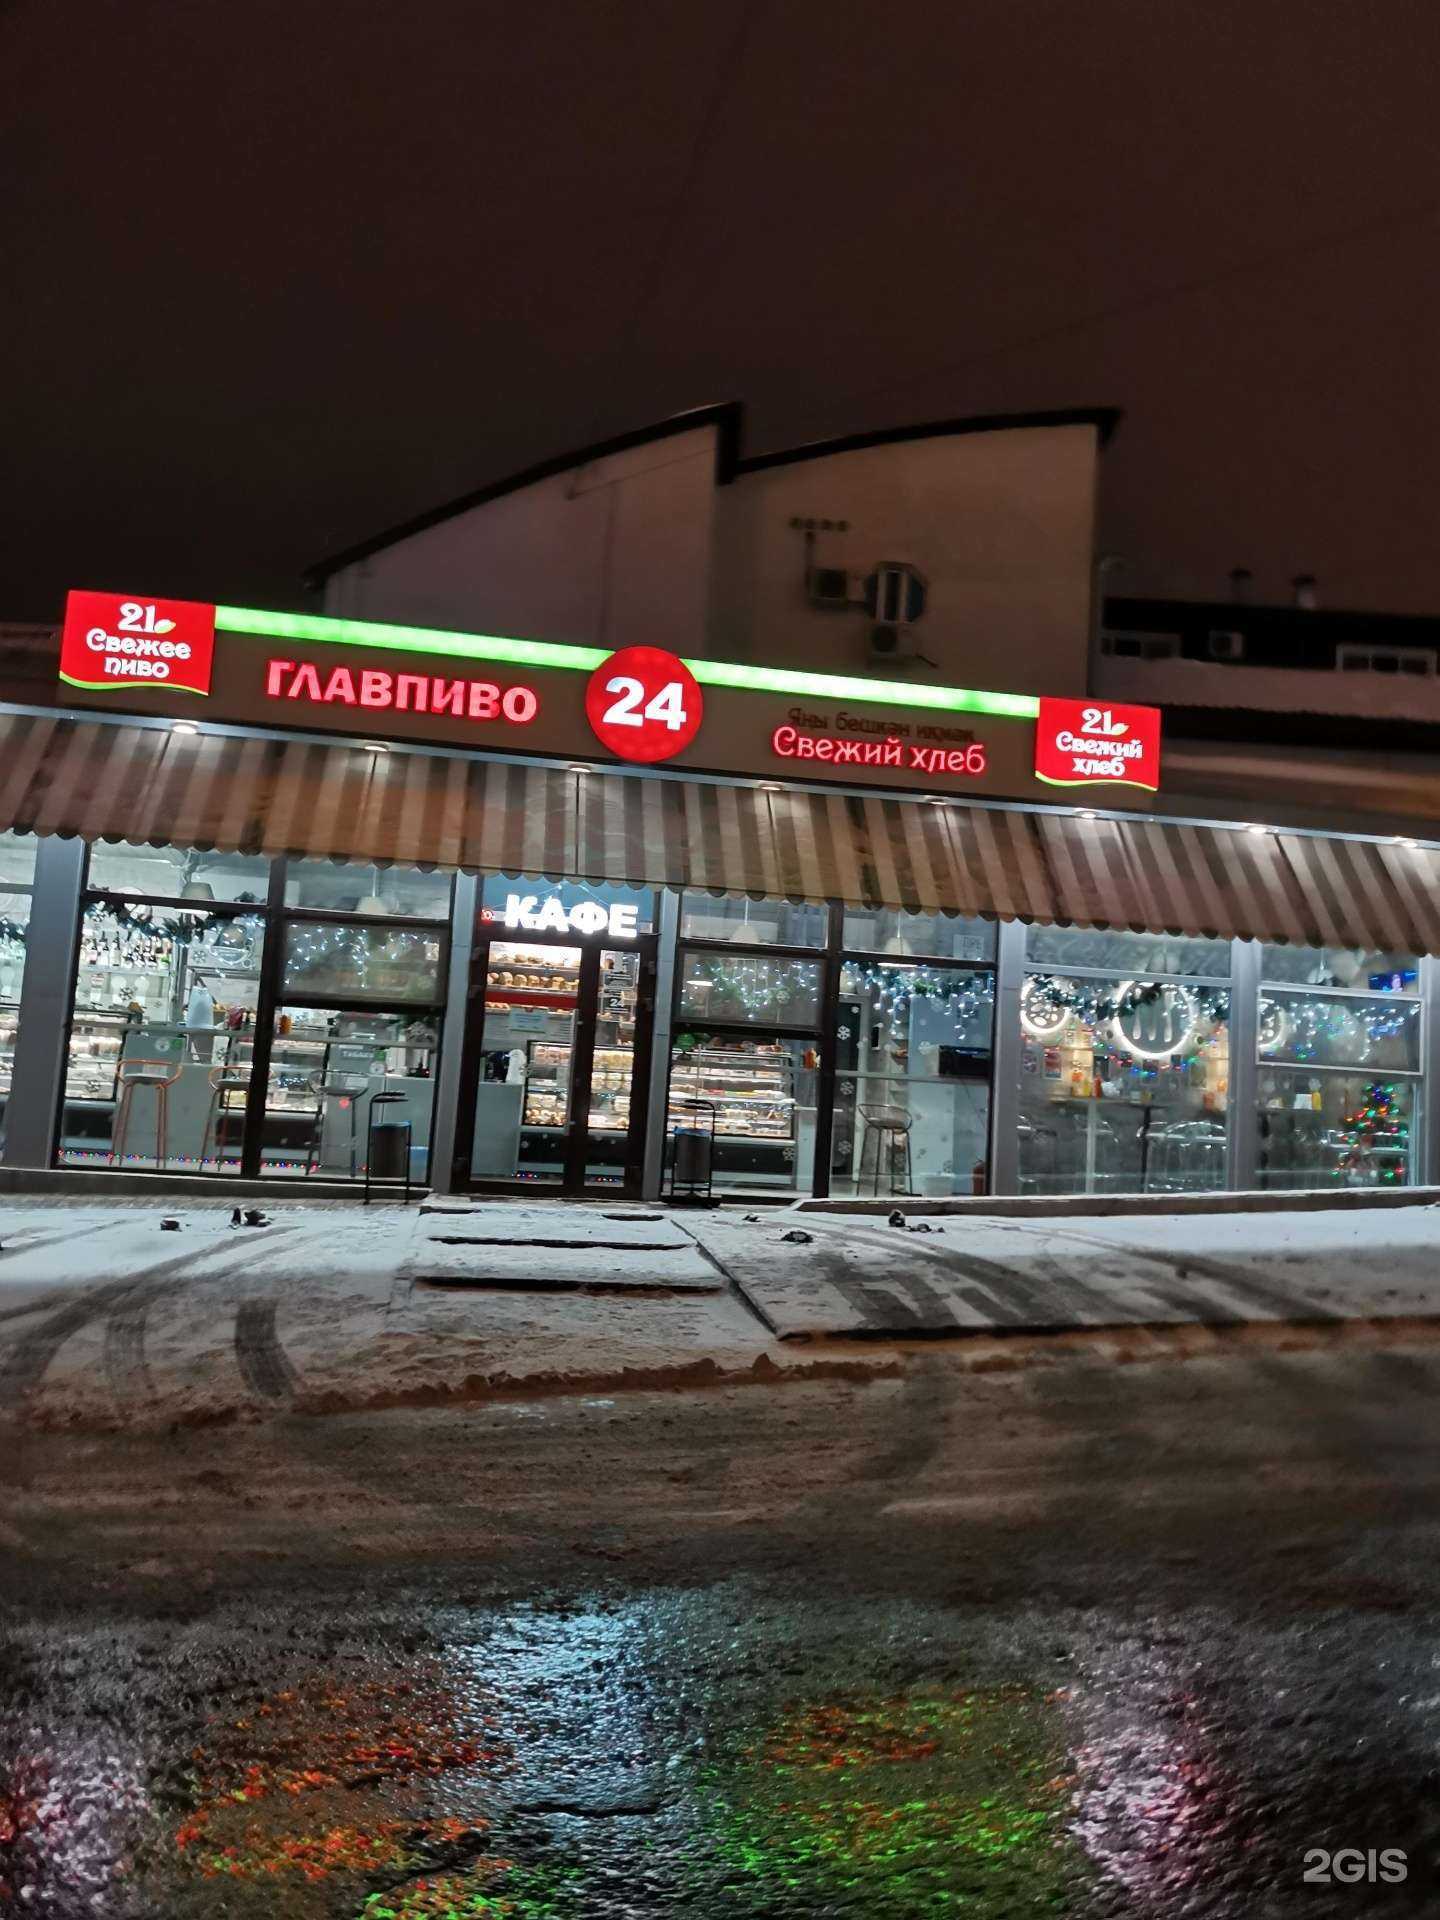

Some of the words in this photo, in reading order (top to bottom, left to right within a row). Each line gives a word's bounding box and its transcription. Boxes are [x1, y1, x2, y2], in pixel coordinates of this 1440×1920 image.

[86, 628, 191, 660] Свежее
[104, 657, 169, 679] пиво
[265, 659, 538, 722] ГЛАВПИВО
[602, 676, 686, 731] 24
[773, 726, 902, 765] Свежий
[909, 743, 985, 773] хлеб
[1056, 731, 1142, 758] Свежий
[1072, 756, 1125, 776] хлеб
[505, 894, 638, 937] КАФЕ
